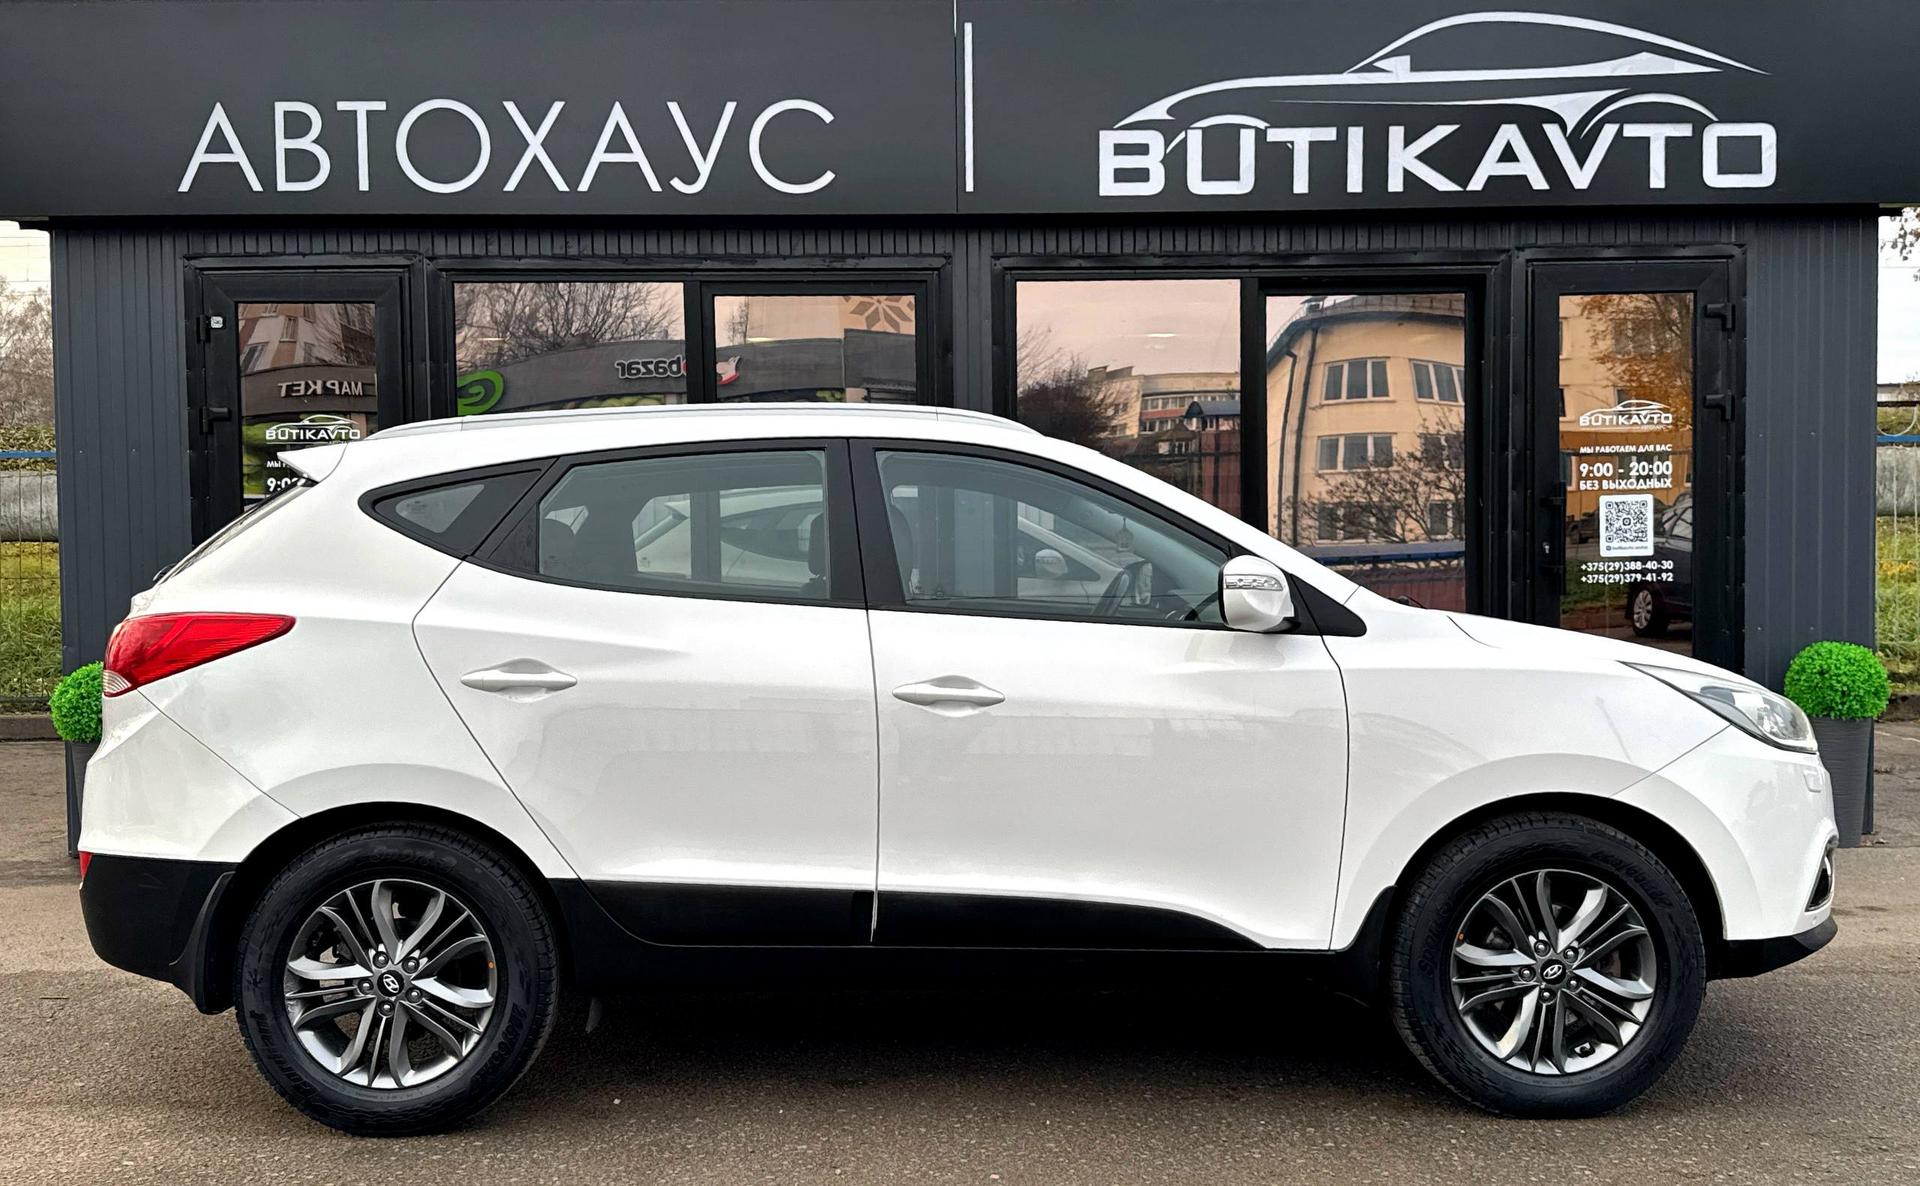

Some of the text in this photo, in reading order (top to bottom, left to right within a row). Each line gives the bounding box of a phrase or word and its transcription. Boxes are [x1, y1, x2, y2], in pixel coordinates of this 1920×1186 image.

[178, 98, 836, 195] АВТОХАУС
[1099, 122, 1778, 197] BUTIKAVTO
[1579, 413, 1673, 427] BUTIKAVTO
[265, 429, 361, 440] BUTIKAVTO
[1580, 443, 1673, 454] МЫ РАБОТАЕМ ДЛЯ ВАС
[266, 460, 281, 468] МЫ
[1580, 462, 1613, 477] 9:00
[1629, 460, 1673, 476] 20:00
[1580, 478, 1673, 490] БЕЗ ВЫХОДНЫХ
[1580, 560, 1674, 573] +375(29)388-40-30
[1580, 572, 1674, 585] +375(29)379-41-92
